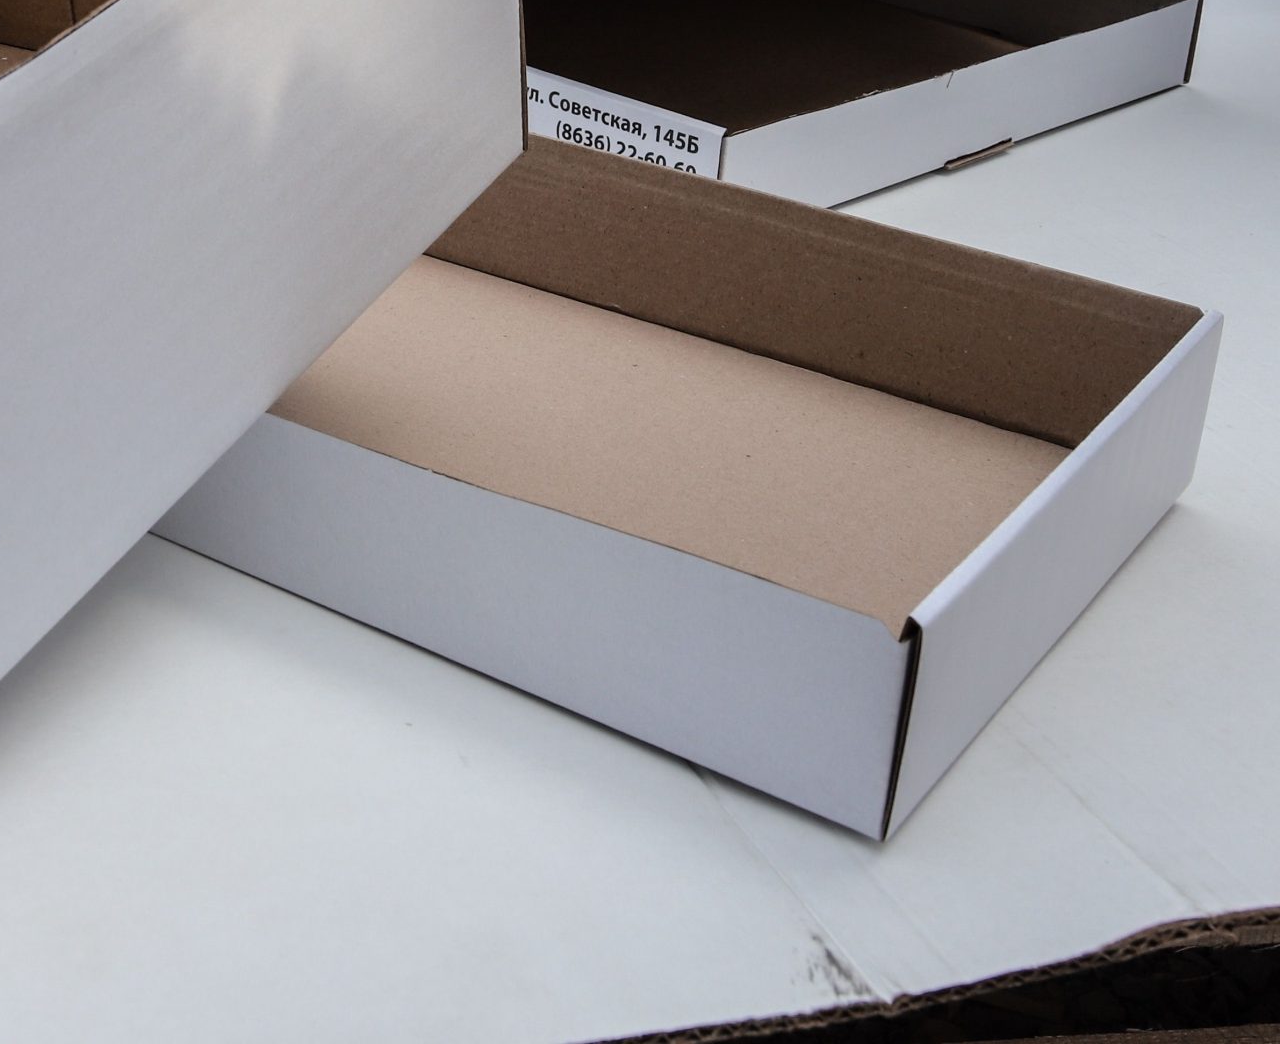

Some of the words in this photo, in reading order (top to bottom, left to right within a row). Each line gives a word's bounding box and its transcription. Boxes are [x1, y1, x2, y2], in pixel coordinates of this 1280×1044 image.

[527, 87, 544, 104] л.
[548, 91, 647, 140] Советская,
[654, 125, 699, 154] 145Б
[556, 120, 611, 152] (8636)
